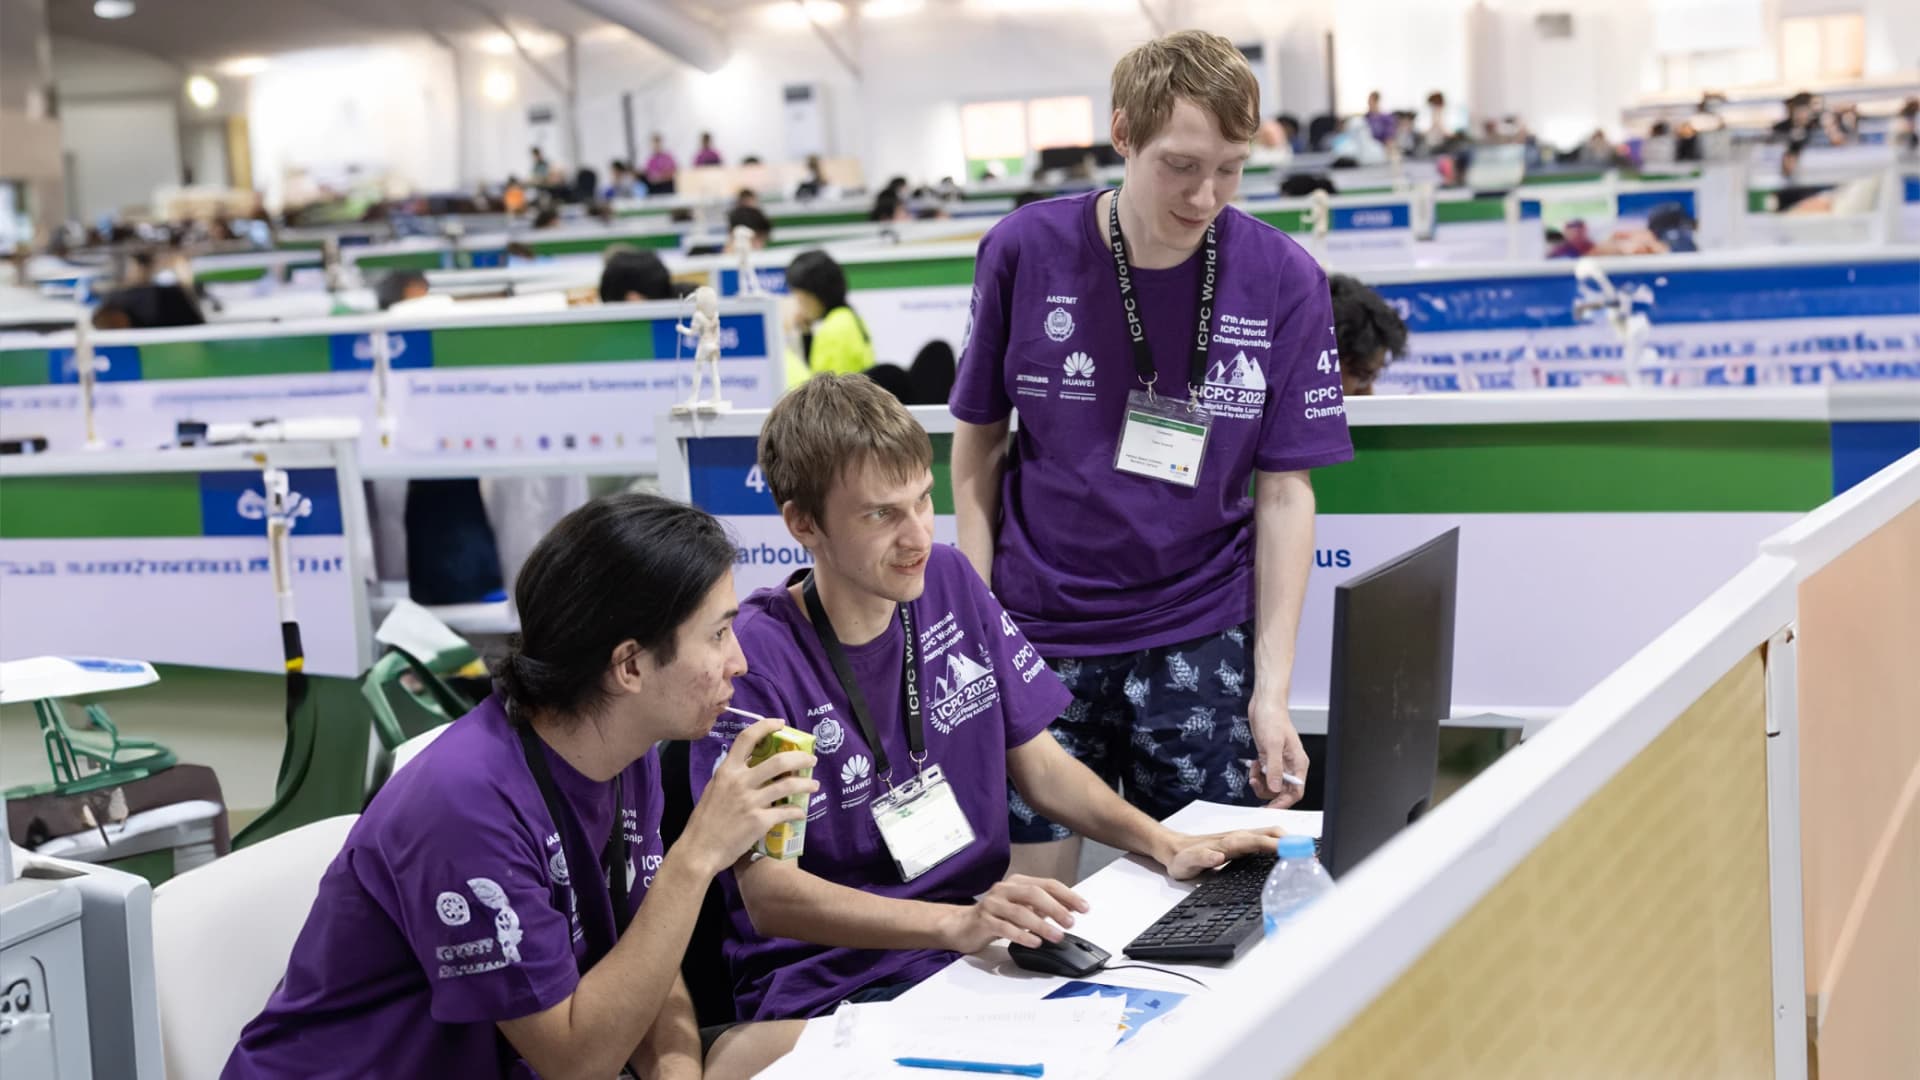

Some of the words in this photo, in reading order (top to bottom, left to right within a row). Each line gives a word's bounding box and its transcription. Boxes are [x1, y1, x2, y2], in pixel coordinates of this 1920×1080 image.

[1112, 241, 1132, 294] World
[1202, 250, 1216, 301] World
[1046, 295, 1078, 304] AASTMT
[1124, 298, 1144, 342] ICPC
[1197, 307, 1212, 351] ICPC
[1220, 314, 1239, 324] 47th
[1240, 317, 1268, 326] Annual
[1220, 325, 1241, 335] ICPC
[1242, 327, 1266, 337] World
[1212, 334, 1271, 349] Championship
[1062, 378, 1095, 388] HUAWEI
[1199, 386, 1235, 402] ICPC
[1237, 390, 1266, 405] 2023
[1304, 386, 1338, 405] ICPC
[901, 608, 914, 664] World
[1012, 644, 1033, 671] ICPC
[907, 669, 920, 716] ICPC
[936, 693, 965, 720] ICPC
[964, 674, 997, 700] 2023
[842, 778, 872, 795] HUAWEI
